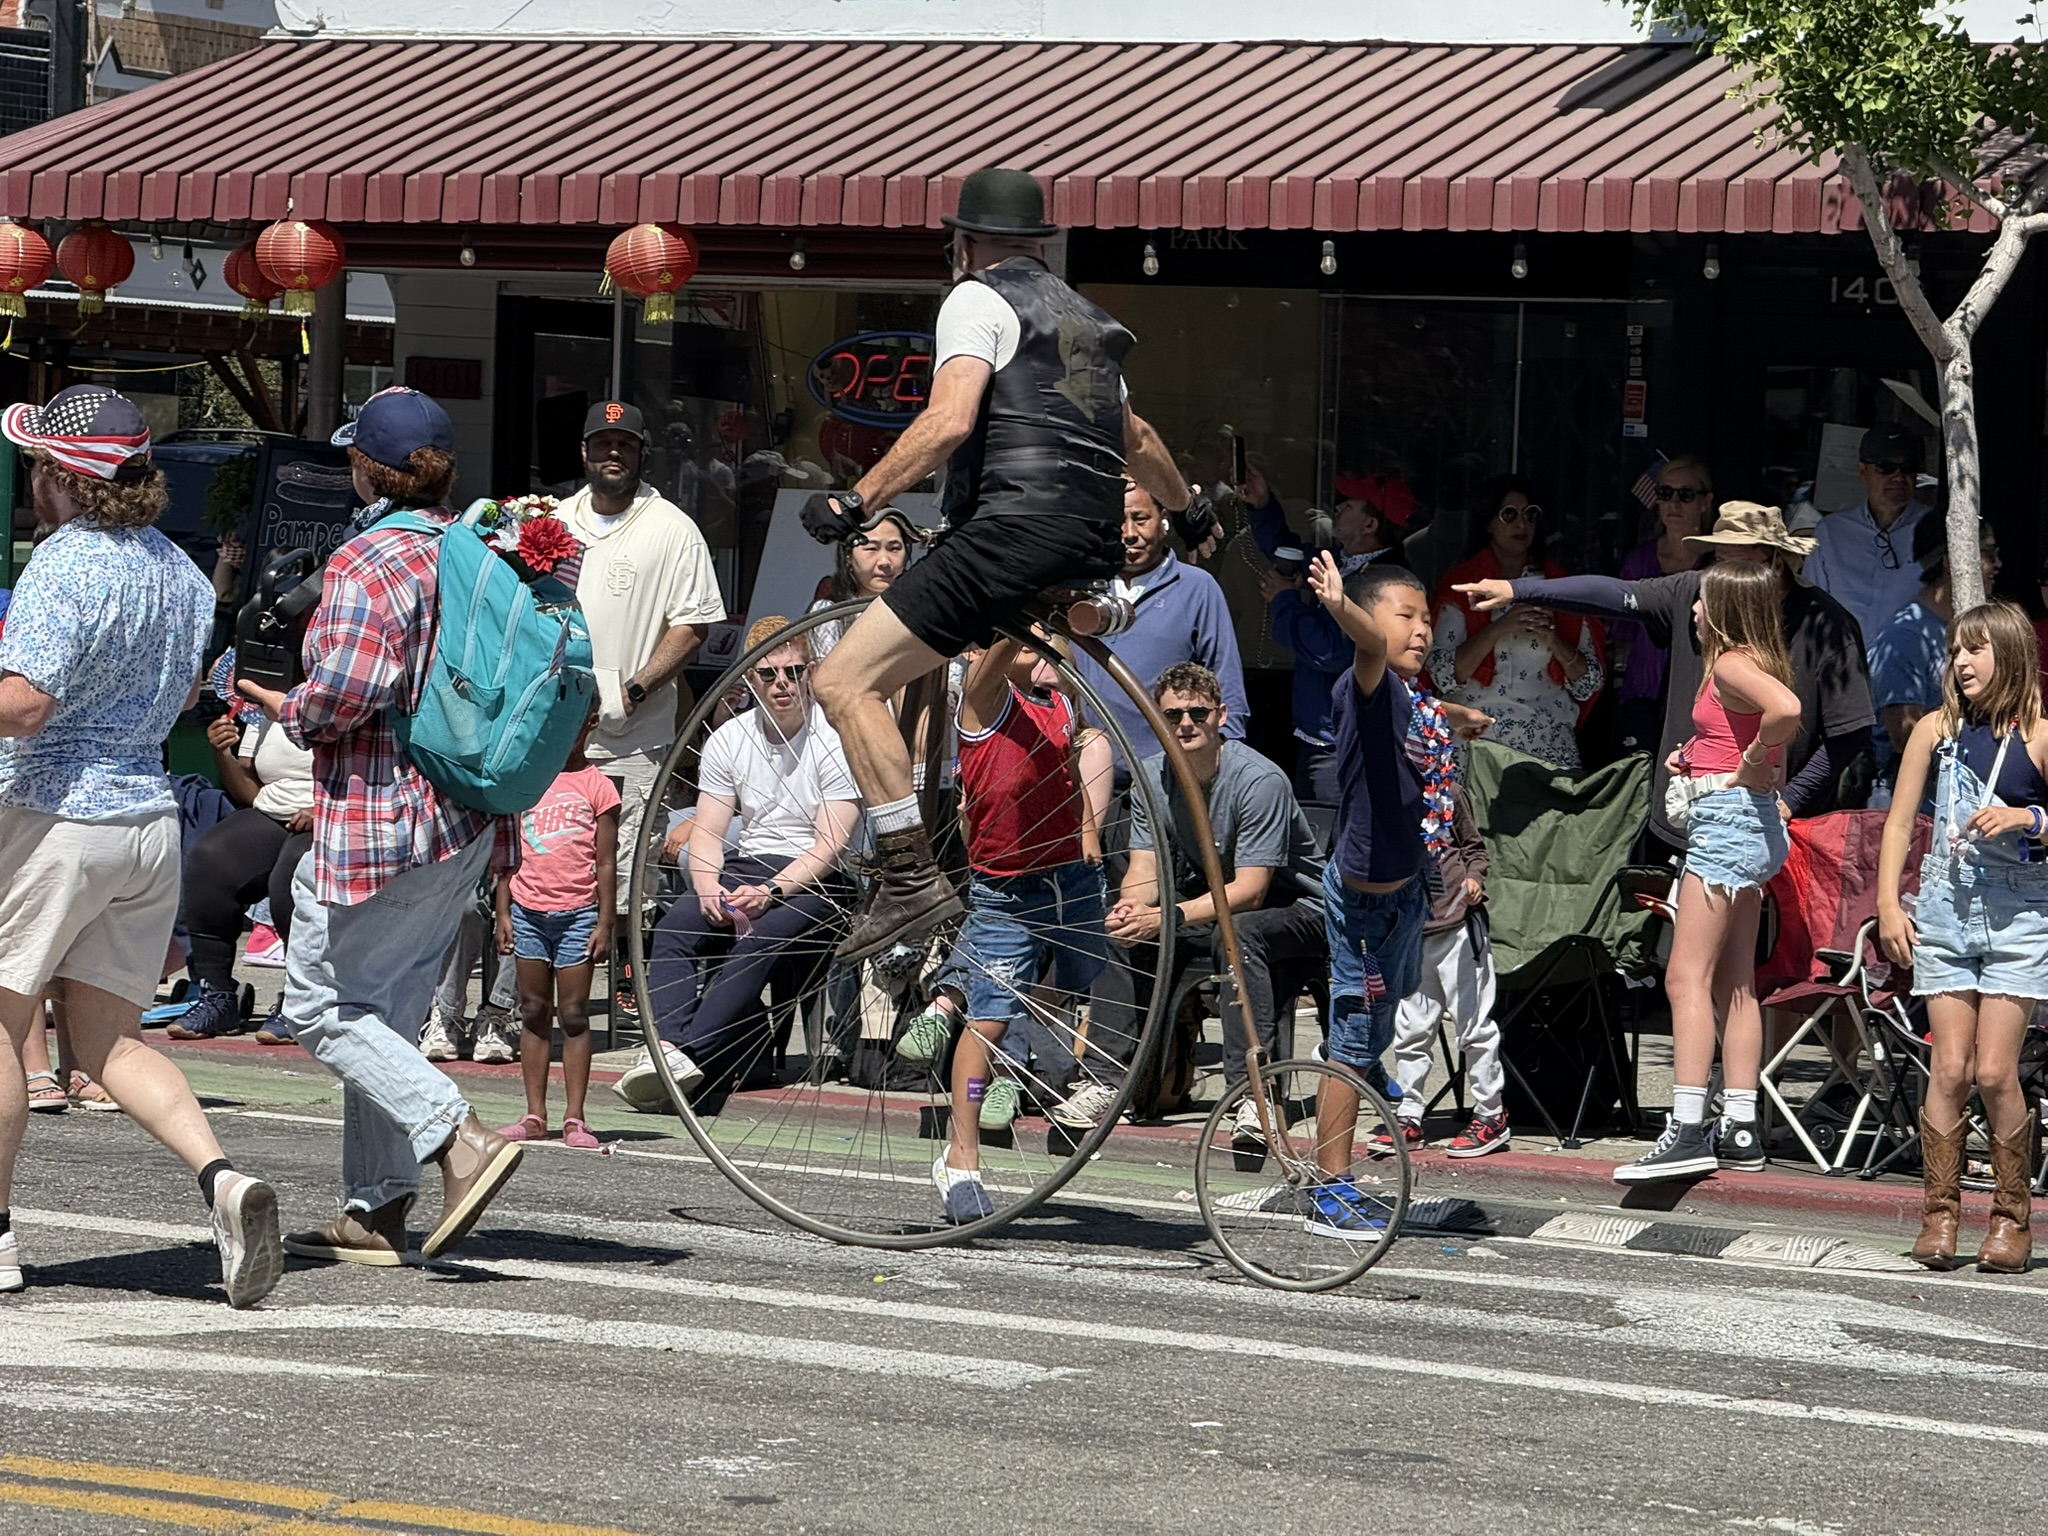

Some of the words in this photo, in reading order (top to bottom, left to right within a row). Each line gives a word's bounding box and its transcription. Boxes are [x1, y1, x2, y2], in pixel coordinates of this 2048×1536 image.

[1170, 228, 1248, 250] PARK
[1831, 276, 1898, 304] 140
[832, 352, 931, 401] OPE
[605, 403, 624, 423] SF
[259, 503, 345, 562] Pampe
